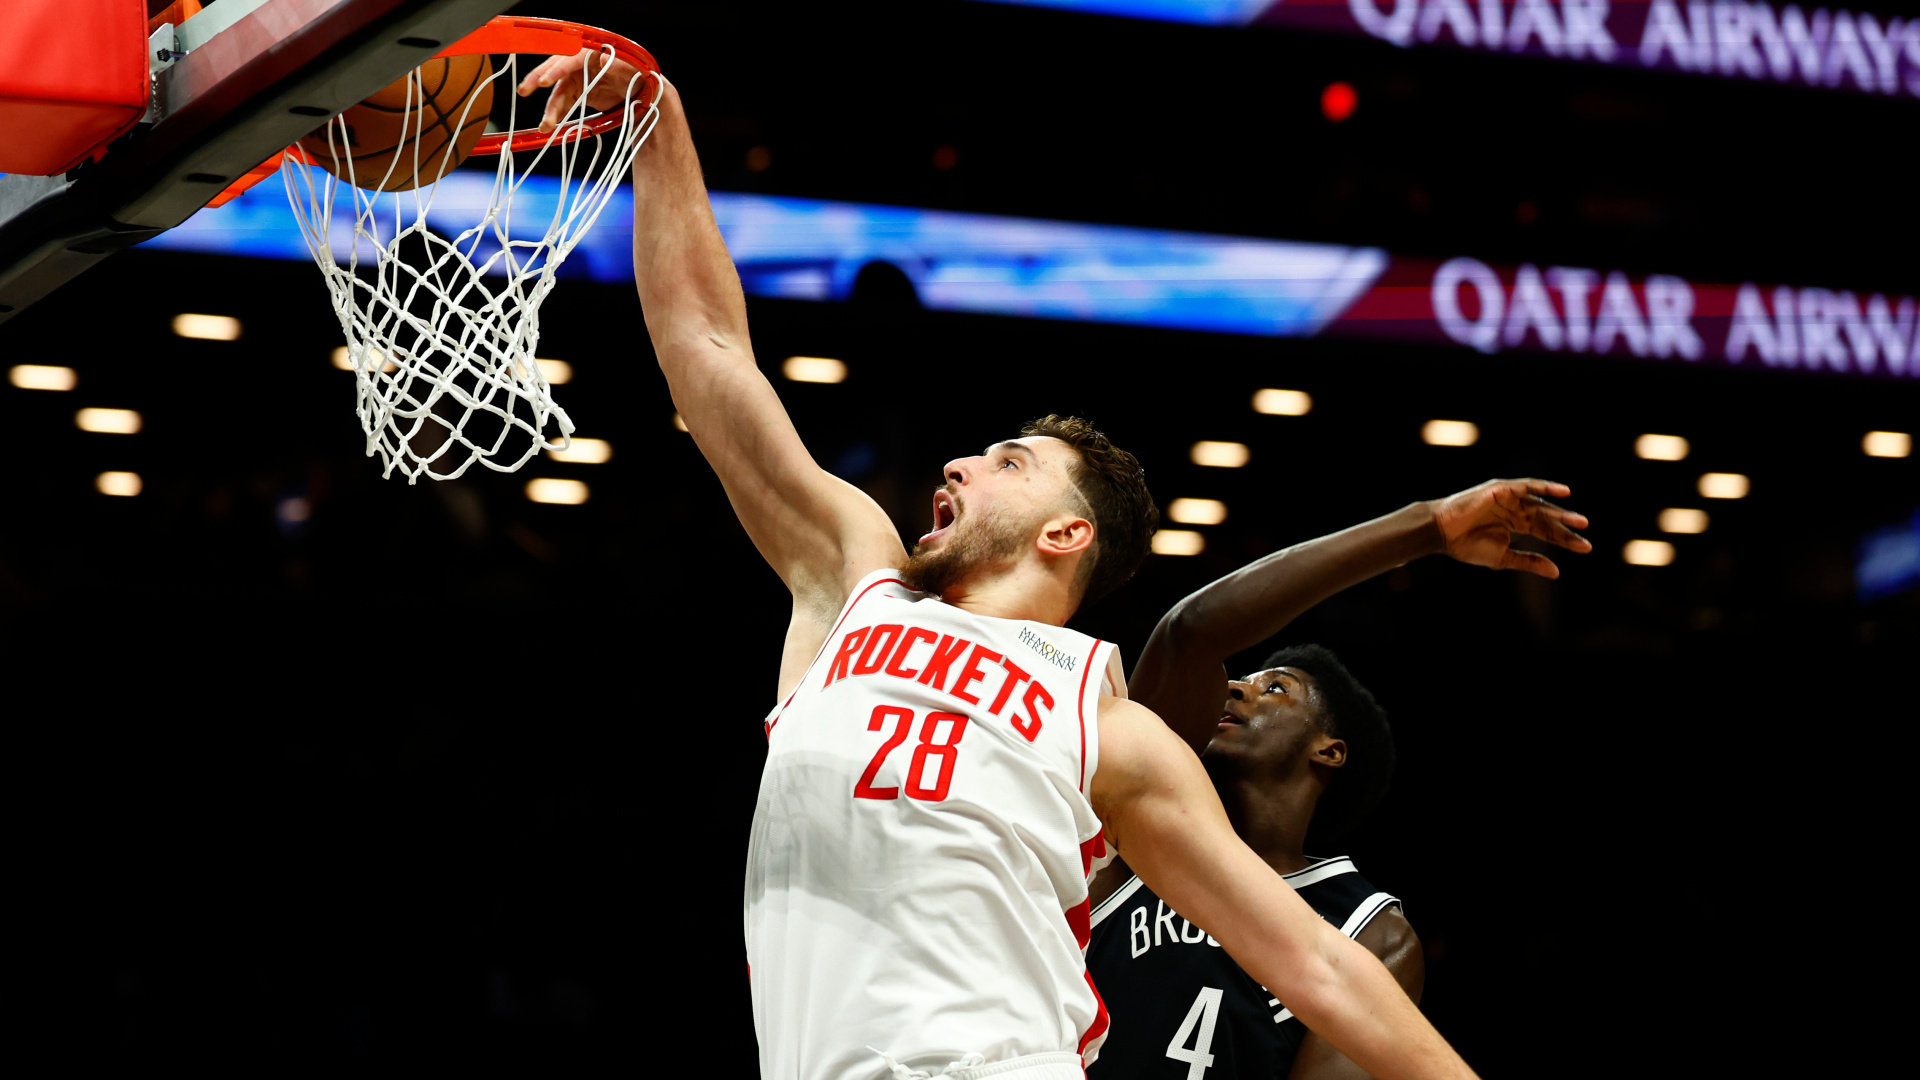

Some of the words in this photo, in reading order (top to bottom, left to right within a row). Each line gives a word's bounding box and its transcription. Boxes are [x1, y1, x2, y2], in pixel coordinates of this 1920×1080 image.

[1432, 257, 1702, 361] QATAR
[1726, 282, 1920, 378] AIRW
[821, 624, 1054, 743] ROCKETS
[1018, 632, 1076, 672] HERMANN
[1020, 627, 1076, 665] MEMORIAL
[853, 705, 970, 802] 28
[1165, 986, 1224, 1080] 4
